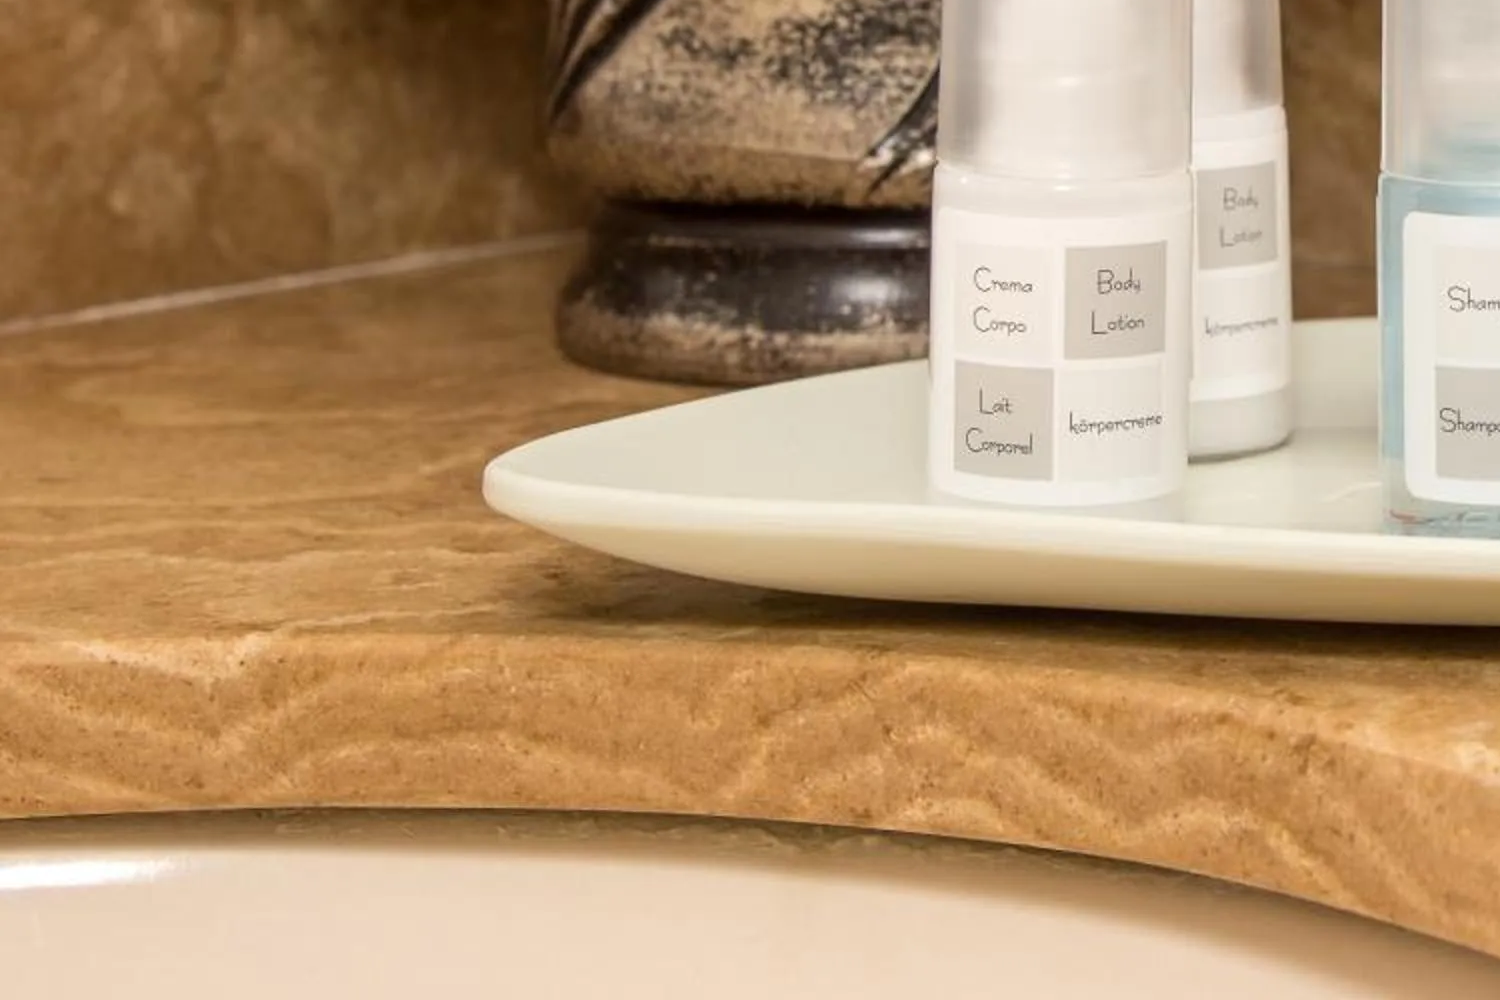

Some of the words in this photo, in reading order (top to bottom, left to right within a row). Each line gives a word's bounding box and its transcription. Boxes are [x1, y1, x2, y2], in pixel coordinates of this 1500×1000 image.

[974, 266, 1033, 293] Crema
[1096, 268, 1141, 294] Body
[973, 306, 1027, 336] Corpo
[1091, 311, 1145, 335] Lotion
[979, 388, 1013, 415] Lait
[1069, 411, 1163, 435] körpercreme
[965, 427, 1033, 456] Corporel
